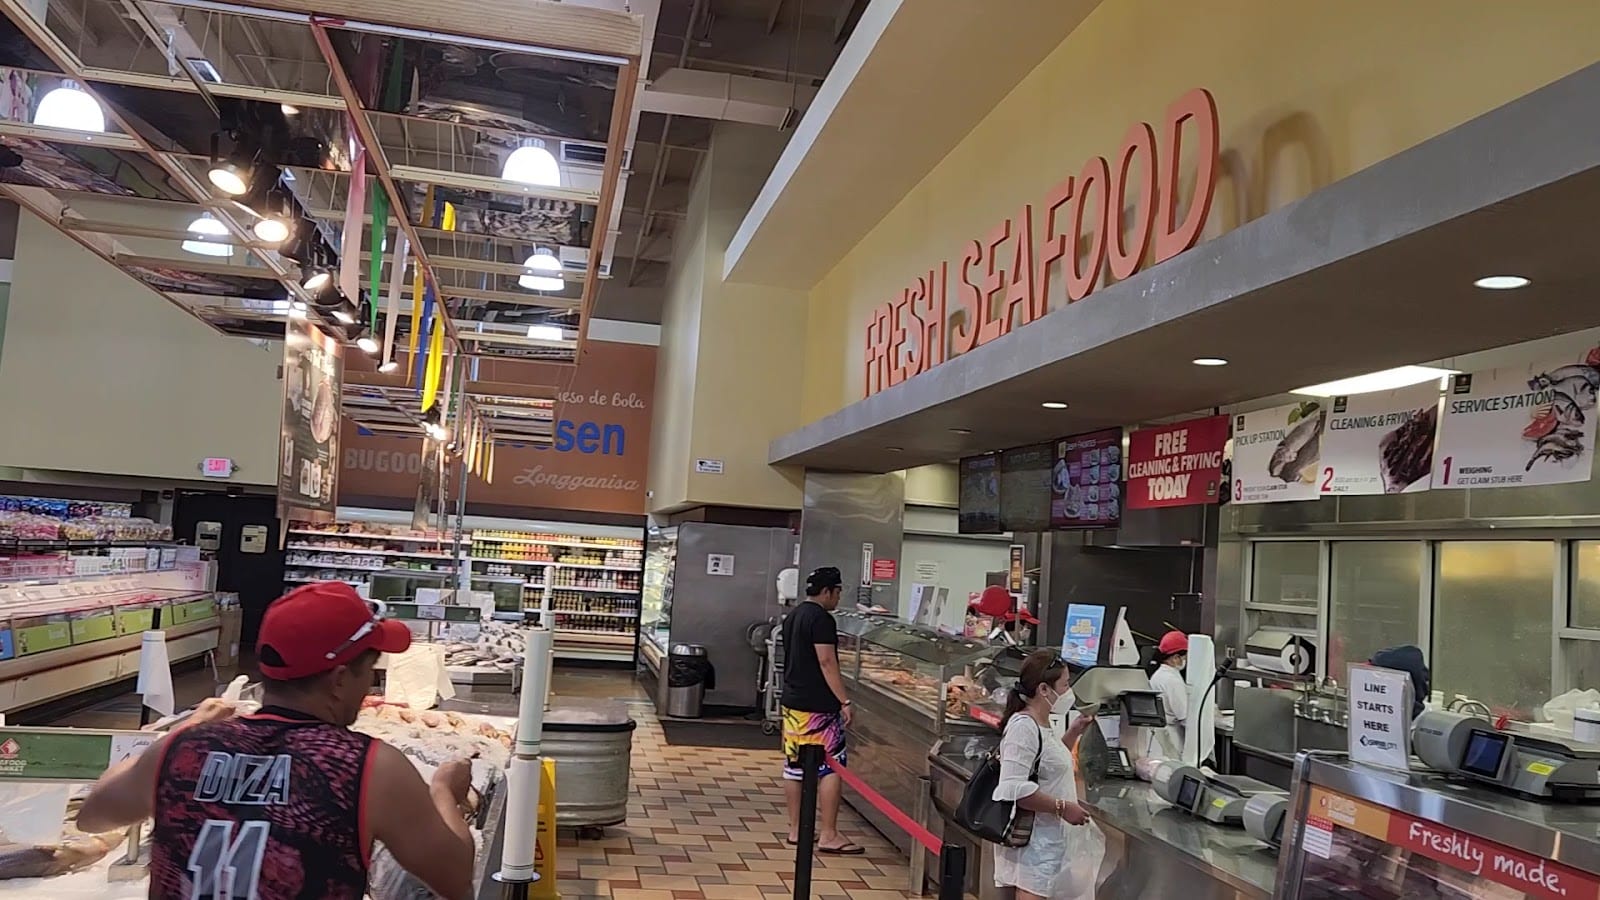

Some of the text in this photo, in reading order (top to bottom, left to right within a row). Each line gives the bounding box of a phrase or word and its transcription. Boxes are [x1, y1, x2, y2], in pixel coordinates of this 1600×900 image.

[864, 88, 1220, 399] FRESH SEAFOOD
[589, 390, 607, 405] de
[1451, 389, 1555, 414] SERVICE STATION
[1330, 409, 1416, 430] CLEANING & FRYING
[555, 419, 625, 456] sen
[1154, 429, 1188, 457] FREE
[1236, 436, 1249, 447] PICK
[1259, 429, 1286, 443] STATION
[344, 447, 421, 474] BUGOO
[1128, 451, 1221, 479] CLEANING & FRYING
[1443, 456, 1453, 485] 1
[1459, 466, 1493, 475] WEIGHING
[513, 465, 640, 491] Longganisa
[1148, 474, 1191, 501] TODAY
[1235, 479, 1242, 501] 3
[1321, 467, 1334, 491] 2
[1457, 477, 1469, 485] GET
[1507, 475, 1523, 483] HERE
[1364, 683, 1387, 694] LINE
[1357, 700, 1394, 714] STARTS
[1363, 720, 1390, 732] HERE
[192, 750, 292, 805] DIZA
[187, 819, 271, 900] 11
[1409, 822, 1566, 896] Freshly made.
